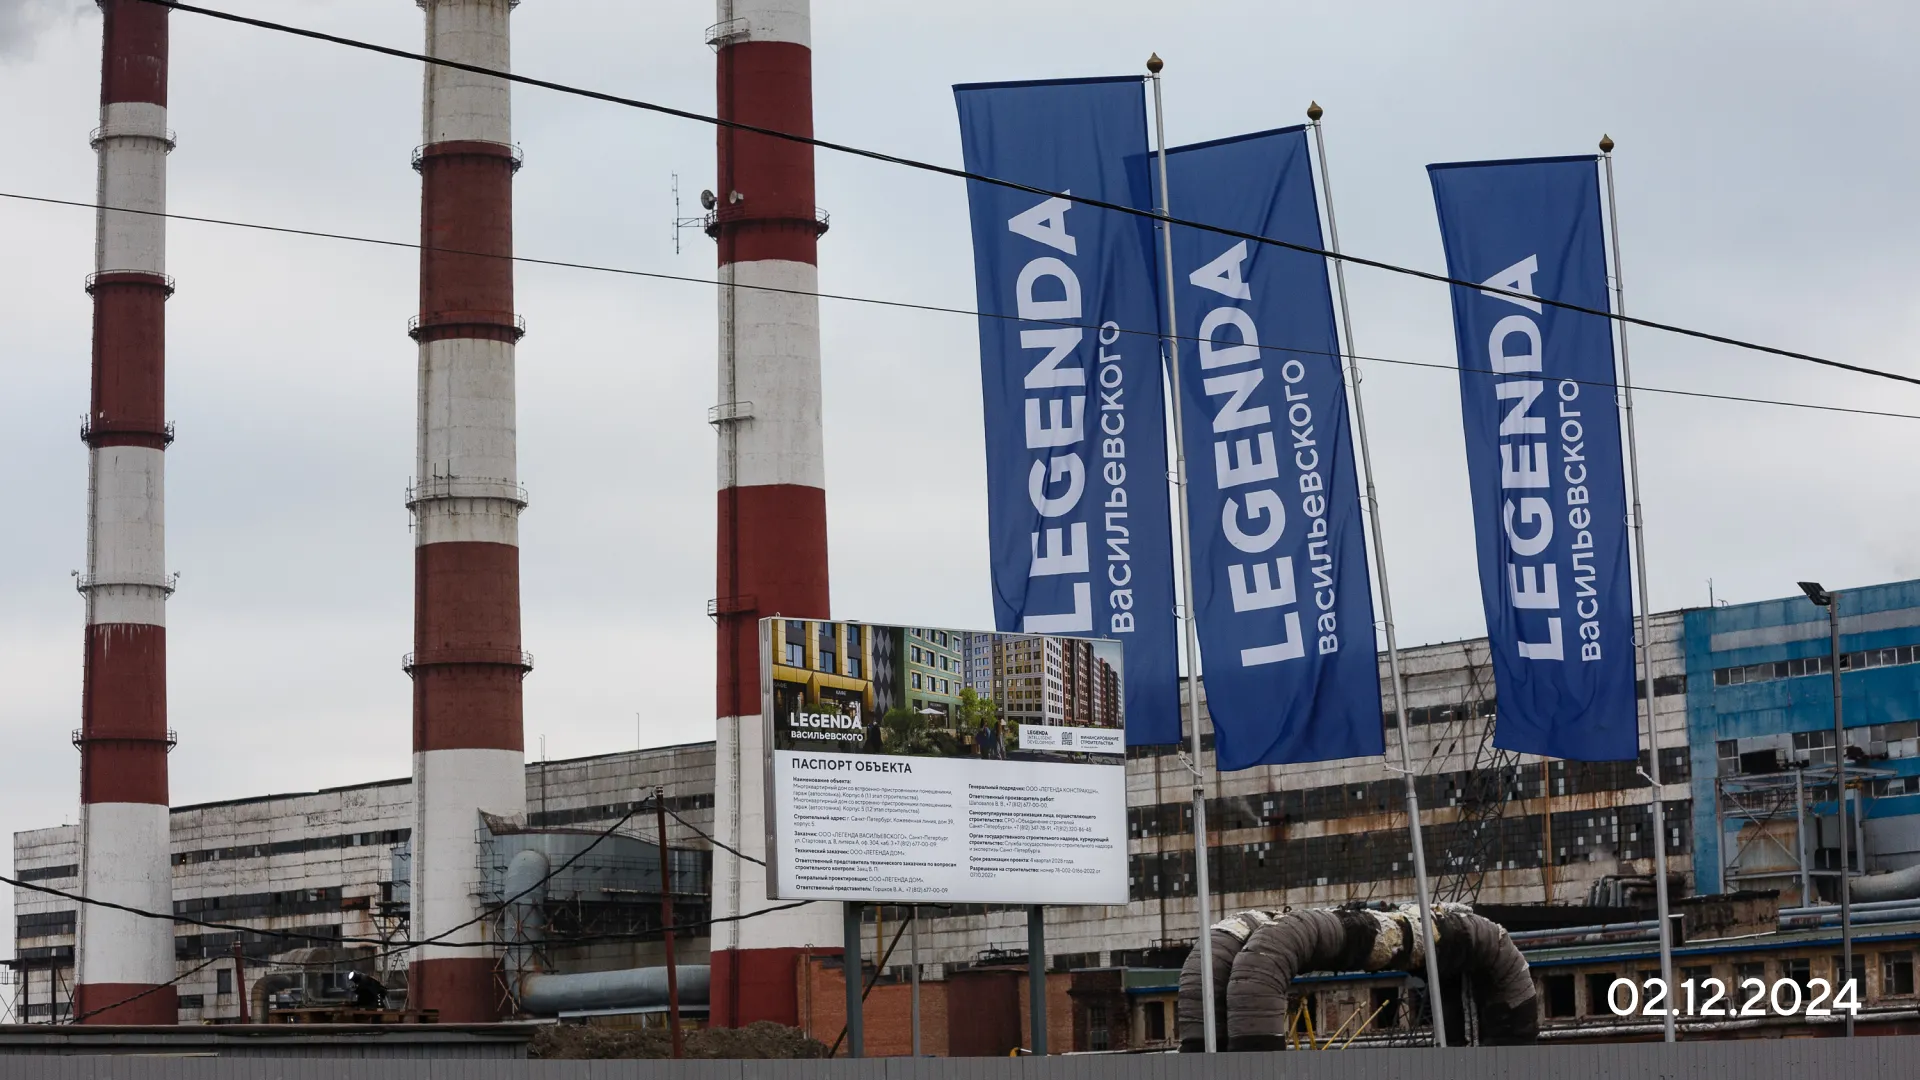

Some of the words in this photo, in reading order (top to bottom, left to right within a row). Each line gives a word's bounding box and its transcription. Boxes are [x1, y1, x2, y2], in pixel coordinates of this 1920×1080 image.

[1007, 189, 1093, 634] LEGENDA
[1099, 320, 1135, 634] васильевского
[1189, 239, 1305, 667] LEGENDA
[1281, 359, 1338, 655] васильевского
[1480, 253, 1564, 661] LEGENDA
[1558, 378, 1602, 662] васильевского
[790, 711, 863, 730] LEGENDA
[791, 730, 864, 742] васильевского
[792, 757, 852, 772] ПАСПОРТ
[855, 760, 913, 774] ОБЪЕКТА
